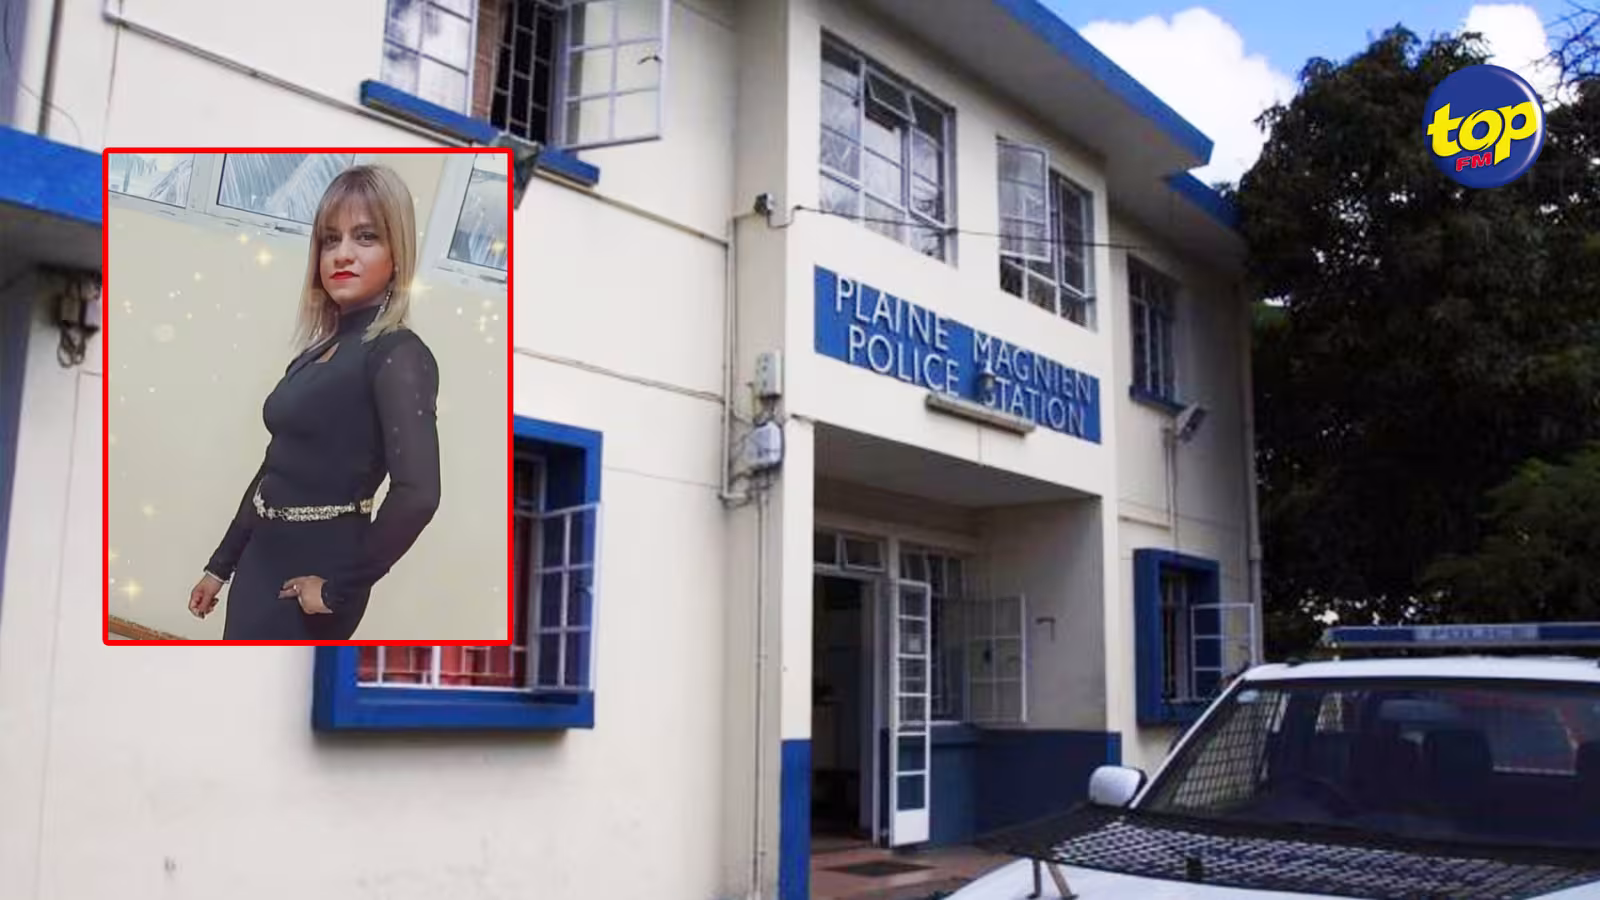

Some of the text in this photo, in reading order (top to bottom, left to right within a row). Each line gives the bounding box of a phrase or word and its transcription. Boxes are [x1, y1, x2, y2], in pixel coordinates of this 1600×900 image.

[835, 274, 1091, 403] PLAINE MAGNIEN
[849, 325, 960, 398] POLICE
